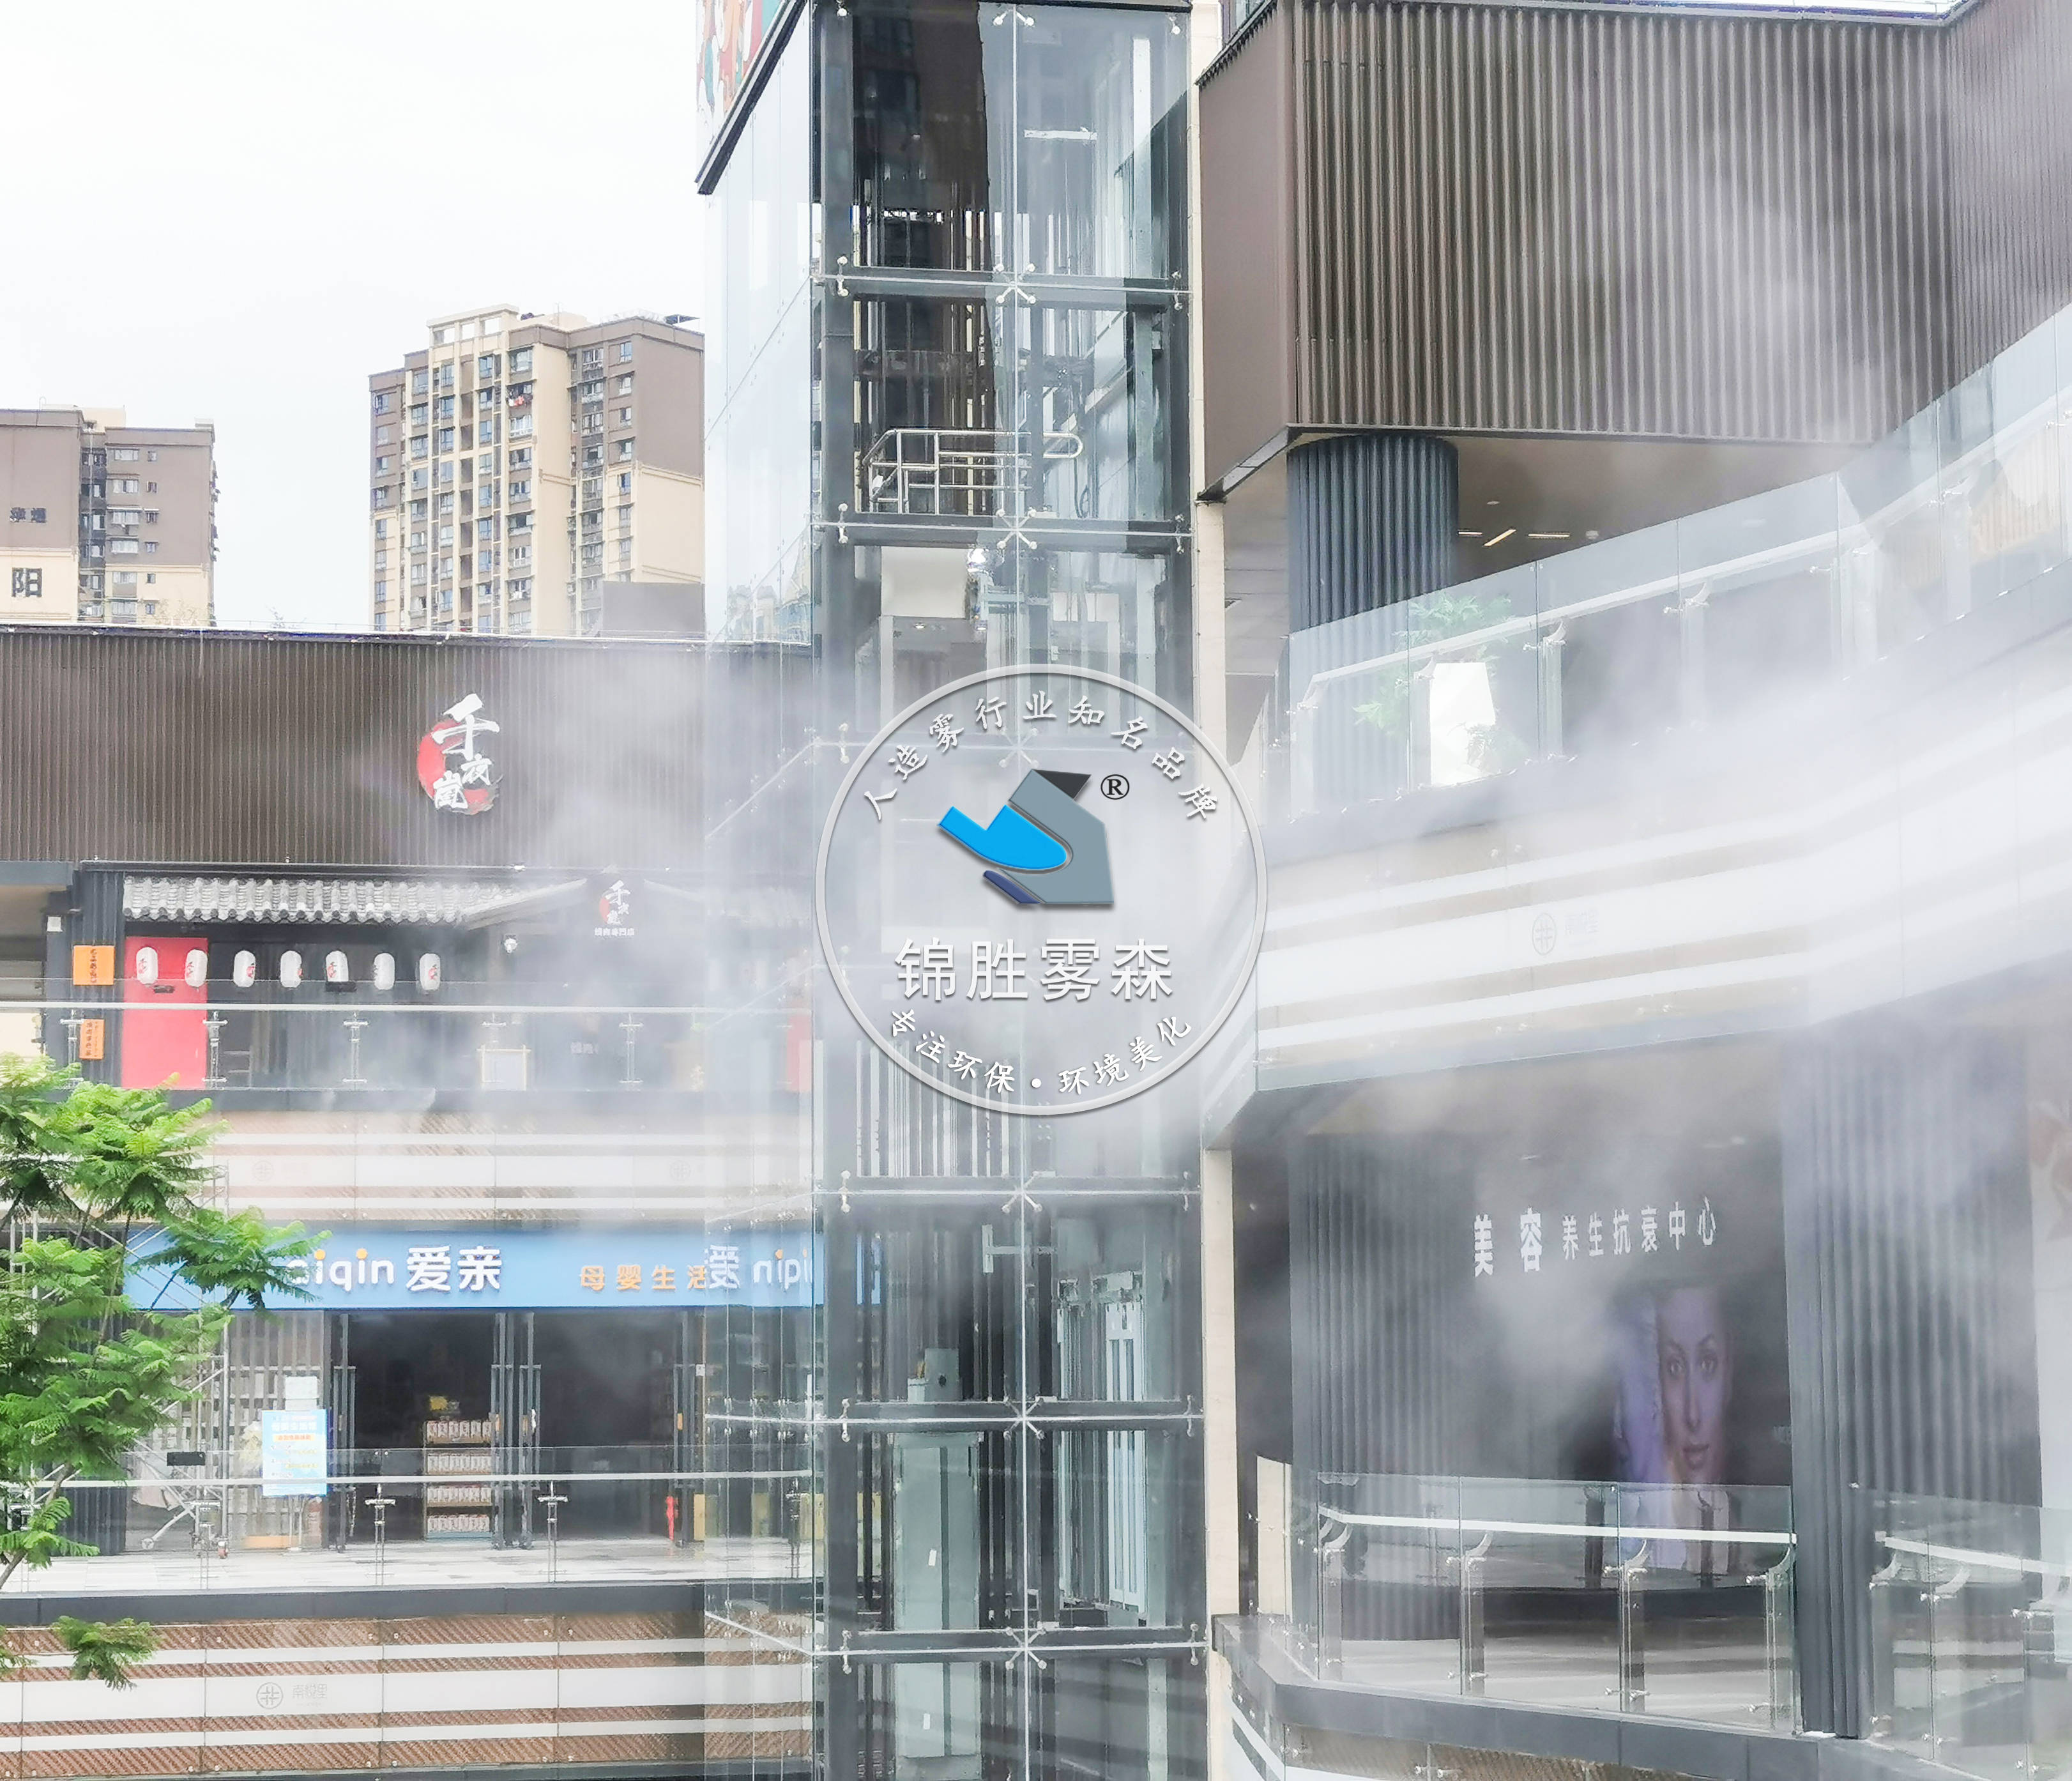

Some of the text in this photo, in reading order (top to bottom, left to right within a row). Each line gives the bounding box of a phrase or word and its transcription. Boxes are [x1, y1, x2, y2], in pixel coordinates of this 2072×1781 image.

[11, 567, 42, 597] 阳
[1474, 1195, 1717, 1278] 美容 养生抗衰中心
[406, 1245, 503, 1292] 爱亲
